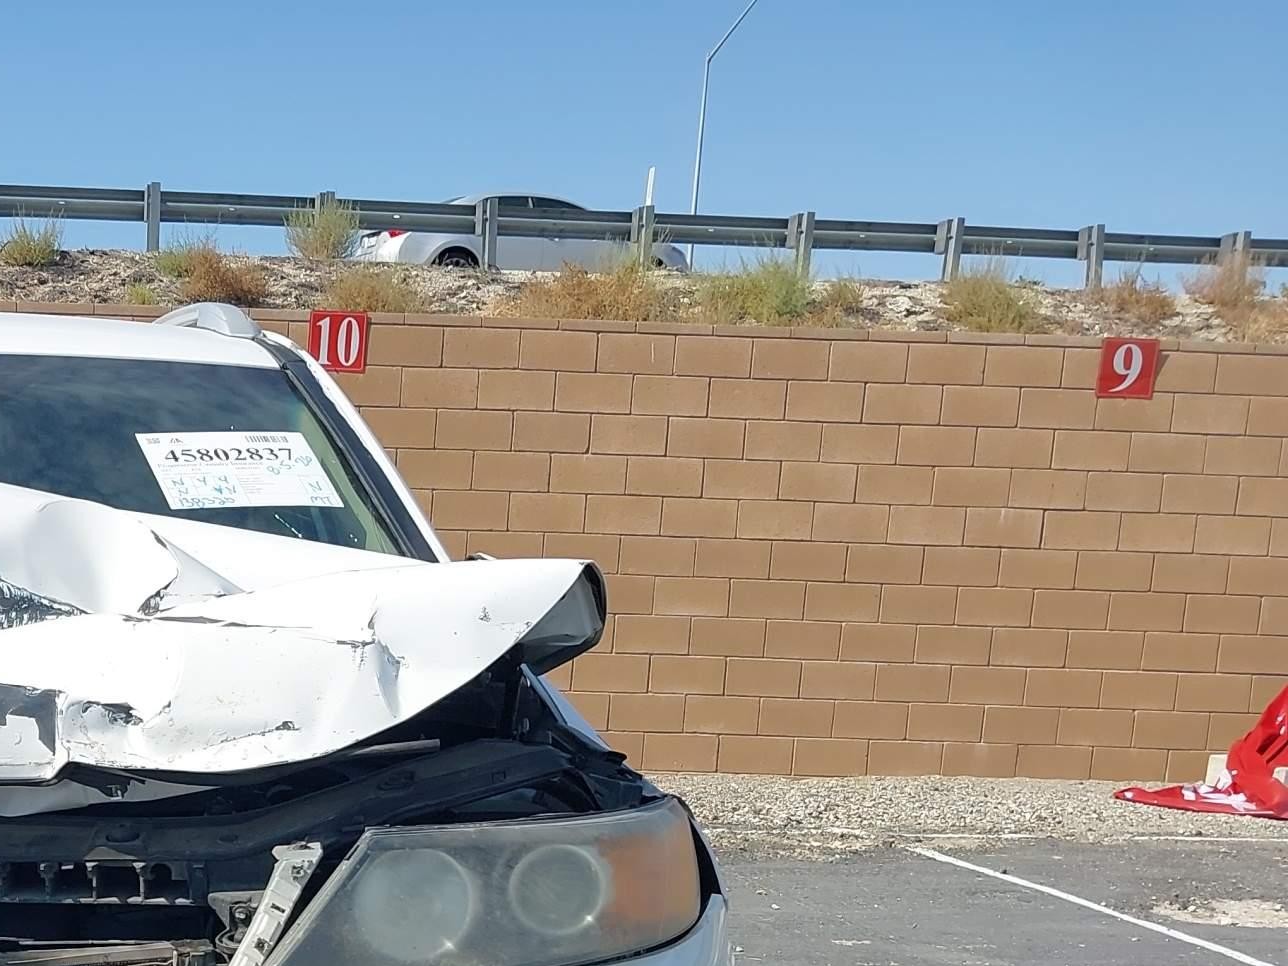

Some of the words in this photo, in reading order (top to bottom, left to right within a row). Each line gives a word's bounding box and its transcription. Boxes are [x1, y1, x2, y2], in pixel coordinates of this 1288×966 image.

[316, 316, 360, 366] 10
[1107, 343, 1143, 392] 9
[164, 447, 293, 463] 45802837
